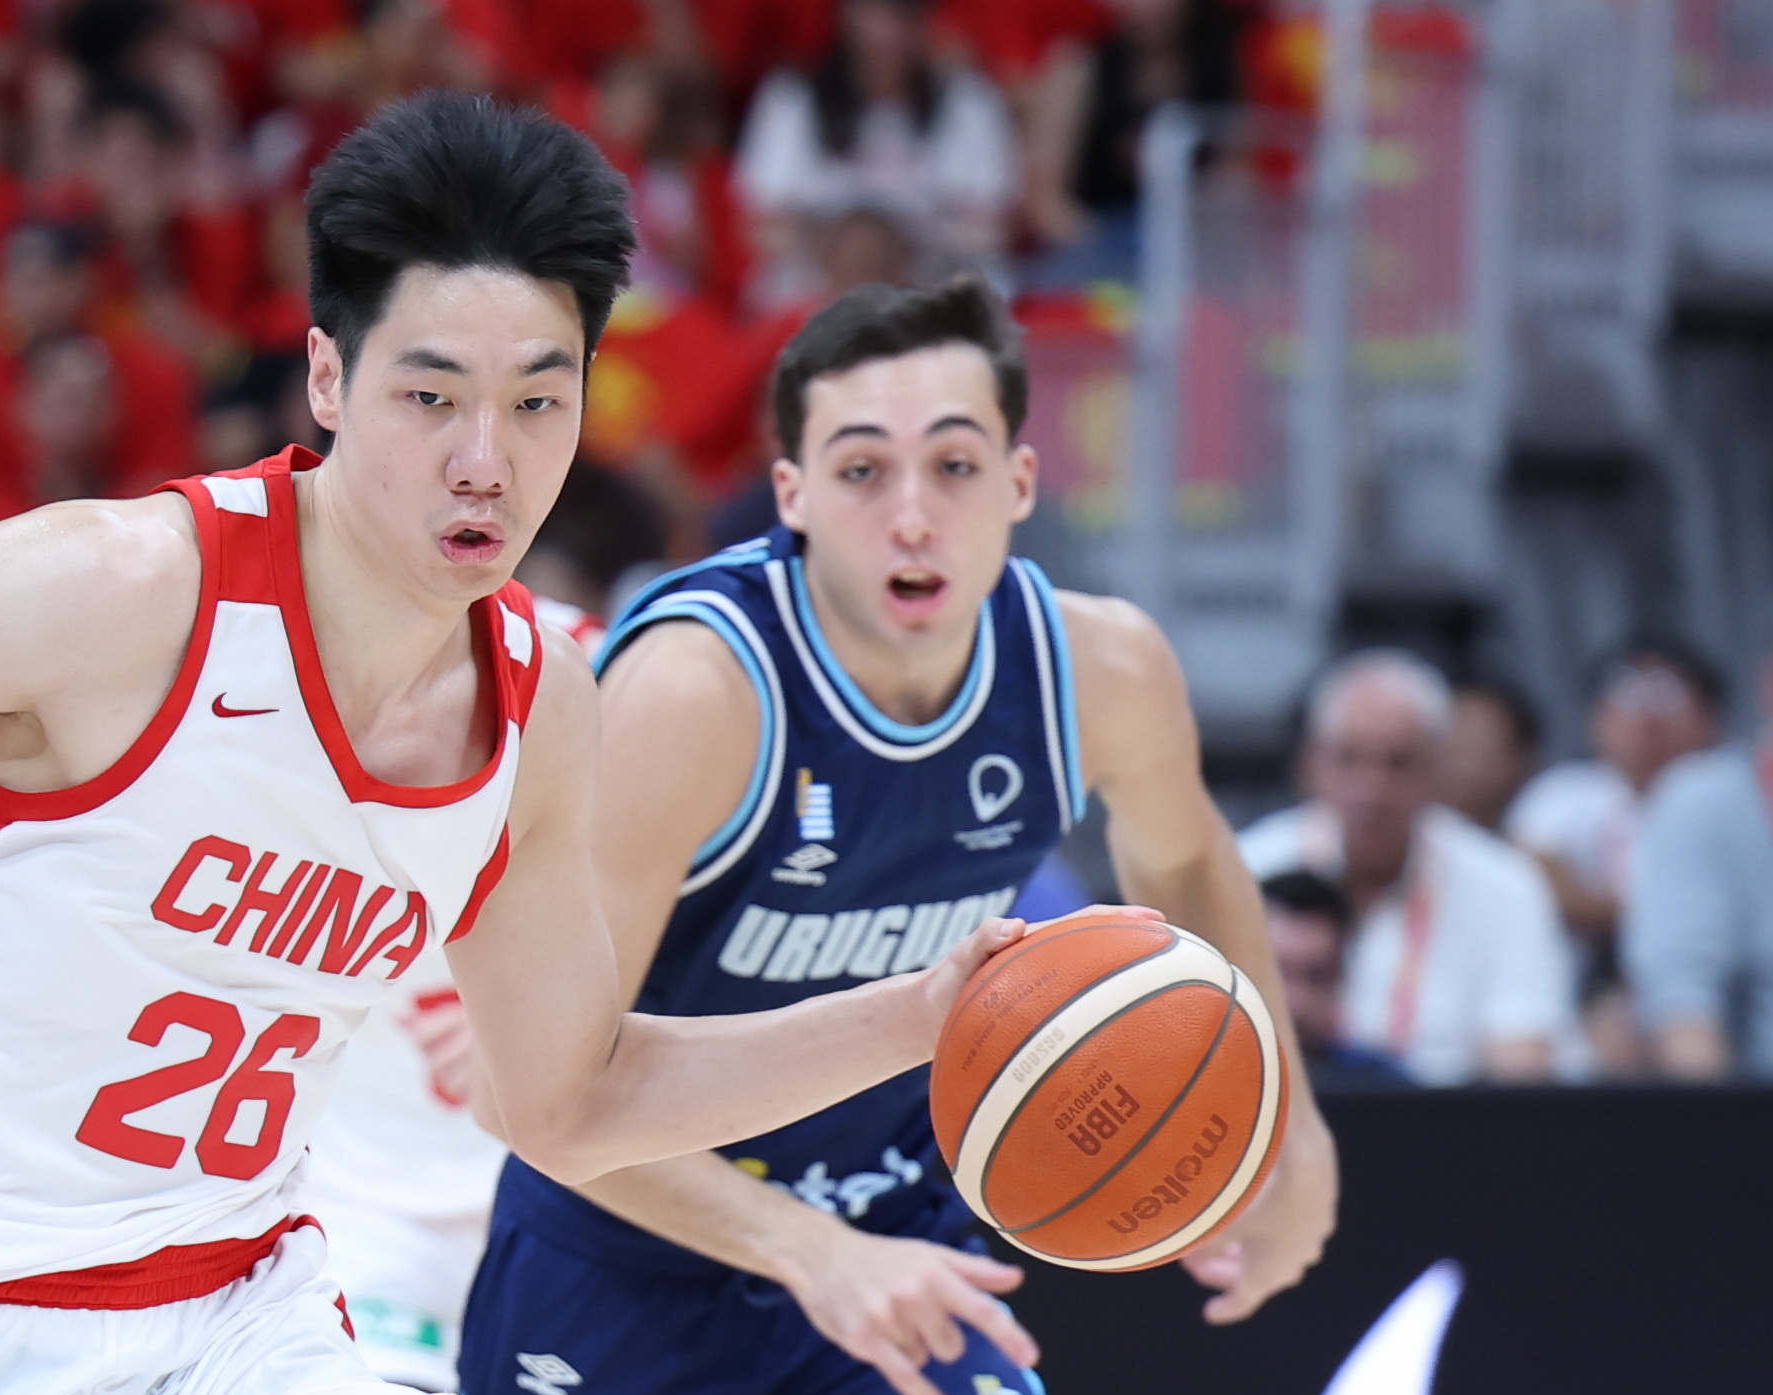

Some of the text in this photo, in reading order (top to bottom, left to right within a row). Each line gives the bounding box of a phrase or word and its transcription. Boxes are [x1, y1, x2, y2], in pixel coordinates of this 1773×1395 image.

[150, 834, 429, 980] CHINA
[75, 991, 320, 1181] 26
[1054, 1069, 1114, 1132] APPROVED
[1067, 1083, 1141, 1157] FIBA
[1107, 1113, 1229, 1235] molten
